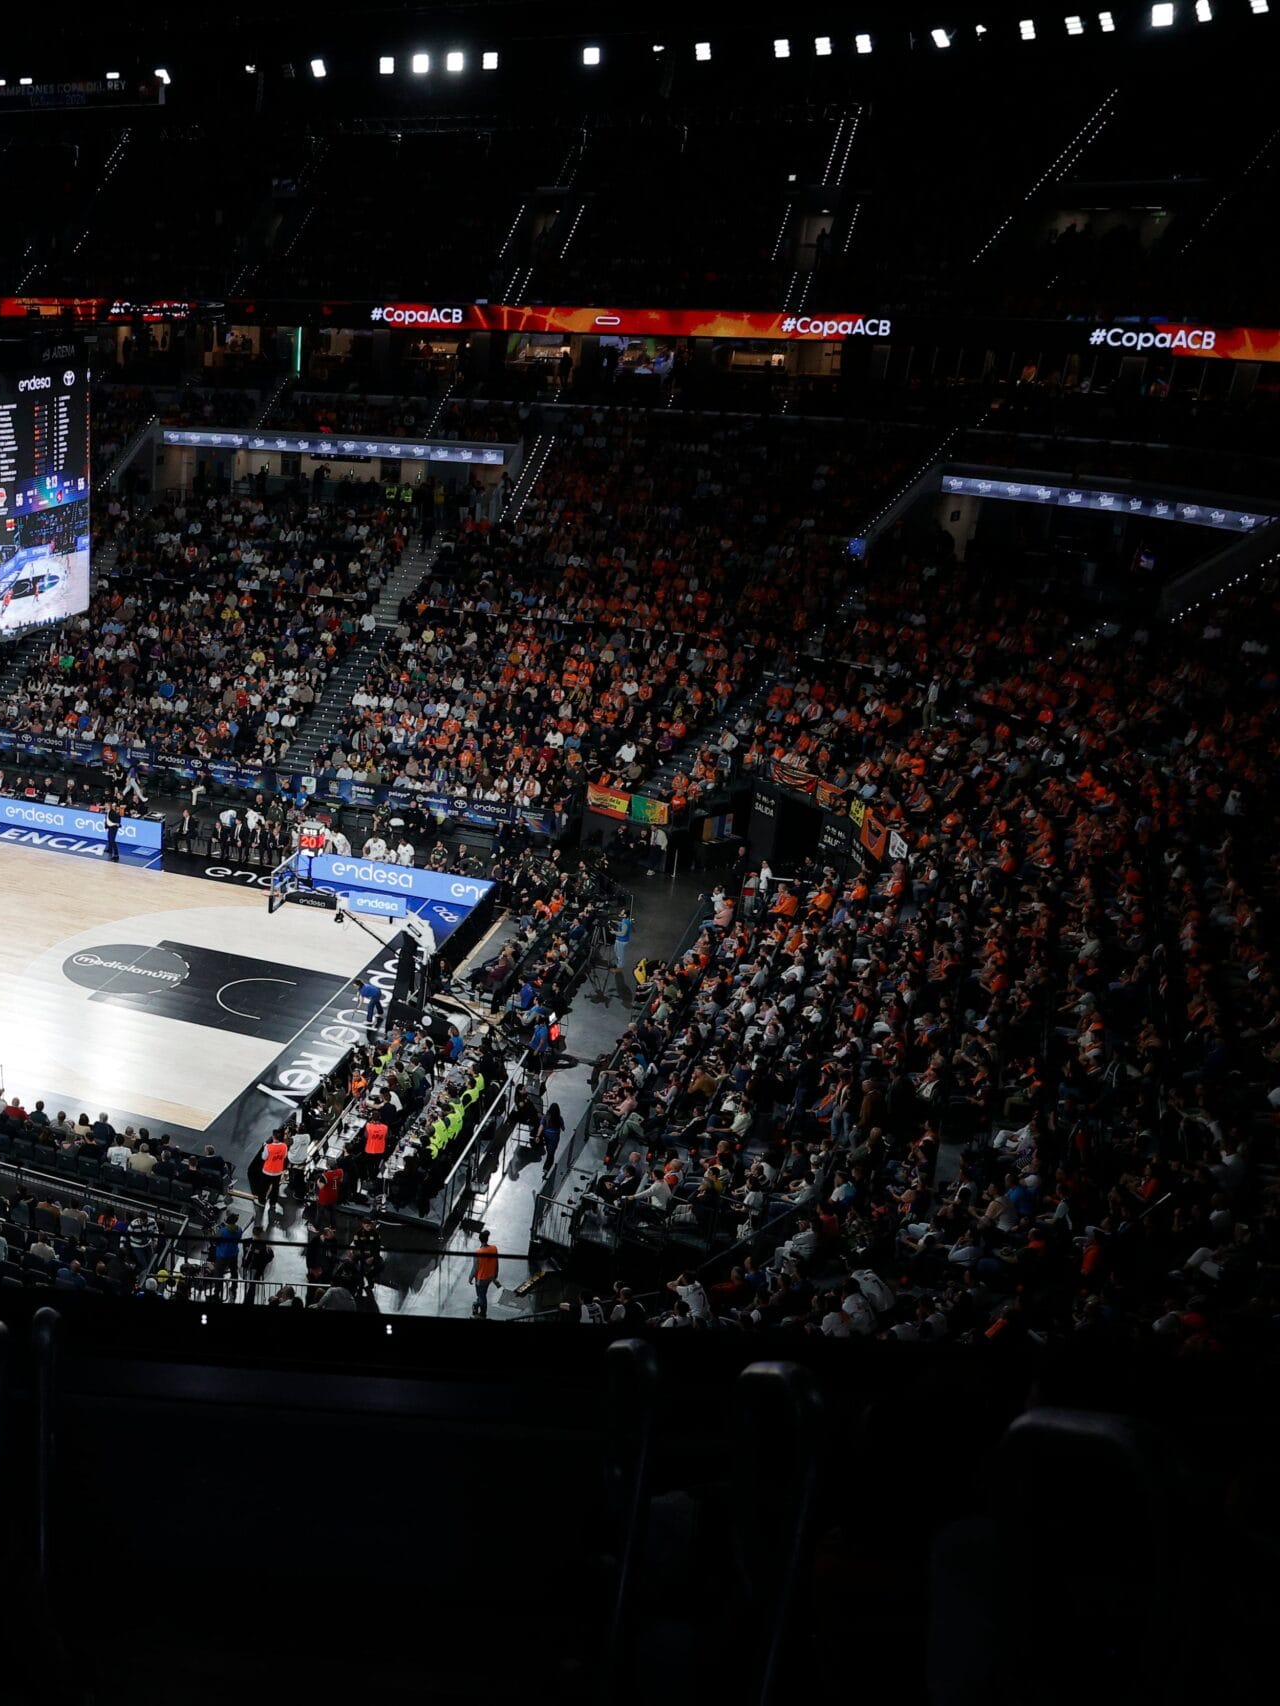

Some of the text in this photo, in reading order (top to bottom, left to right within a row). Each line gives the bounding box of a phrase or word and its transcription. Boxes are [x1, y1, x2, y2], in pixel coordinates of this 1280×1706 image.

[371, 307, 463, 325] #CopaACB
[782, 316, 891, 336] #CopaACB
[1089, 328, 1216, 350] #CopaACB
[18, 376, 51, 392] endesa
[37, 737, 63, 747] endesa
[158, 754, 185, 765] endesa
[473, 803, 507, 815] endesa
[6, 806, 64, 826] endesa
[75, 817, 136, 838] endsa
[301, 836, 317, 848] 20
[332, 862, 413, 889] endesa
[299, 898, 326, 907] endesa
[357, 898, 398, 911] endesa
[432, 905, 459, 924] acb
[73, 954, 179, 982] mediolanum
[256, 1051, 335, 1109] Rey
